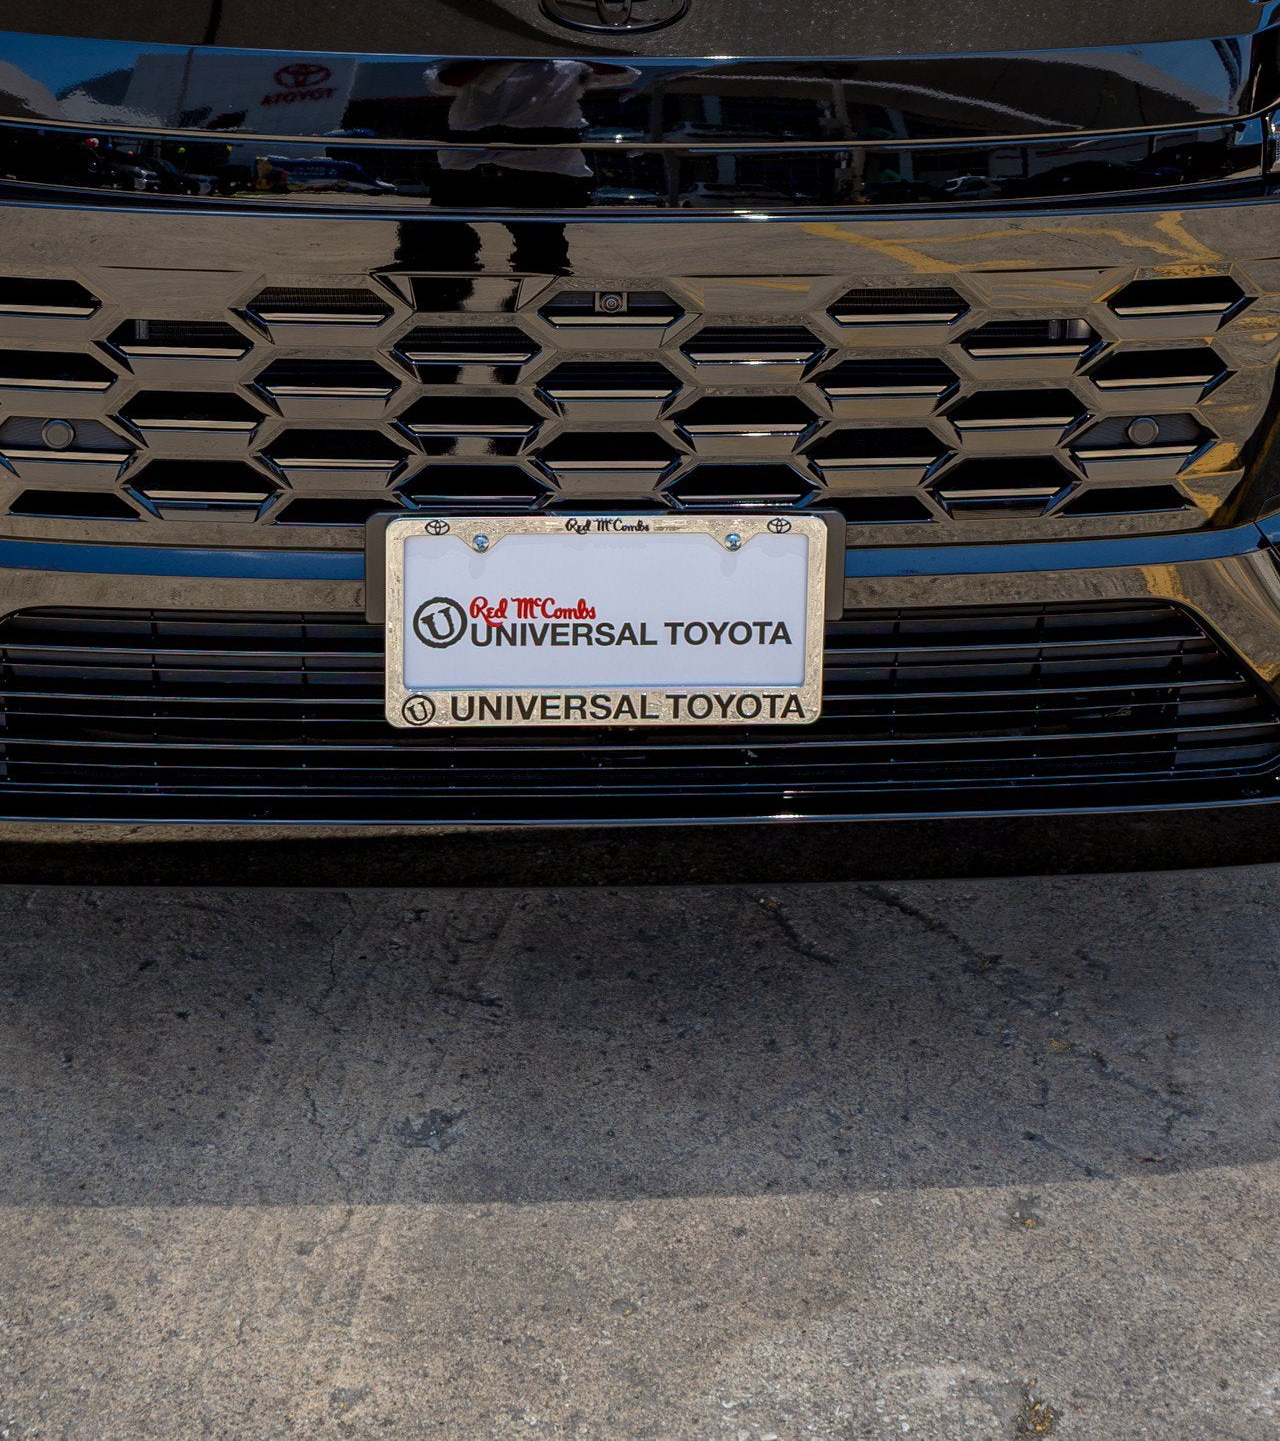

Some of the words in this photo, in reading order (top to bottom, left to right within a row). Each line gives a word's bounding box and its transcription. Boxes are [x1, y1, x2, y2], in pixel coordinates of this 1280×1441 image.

[565, 518, 592, 535] Red
[593, 518, 650, 532] McCombs
[469, 595, 508, 628] Red
[511, 596, 597, 620] McCombs
[471, 621, 658, 647] UNIVERSAL
[664, 620, 793, 646] TOYOTA
[450, 694, 659, 722] UNIVERSAL
[664, 693, 806, 720] TOYOTA
